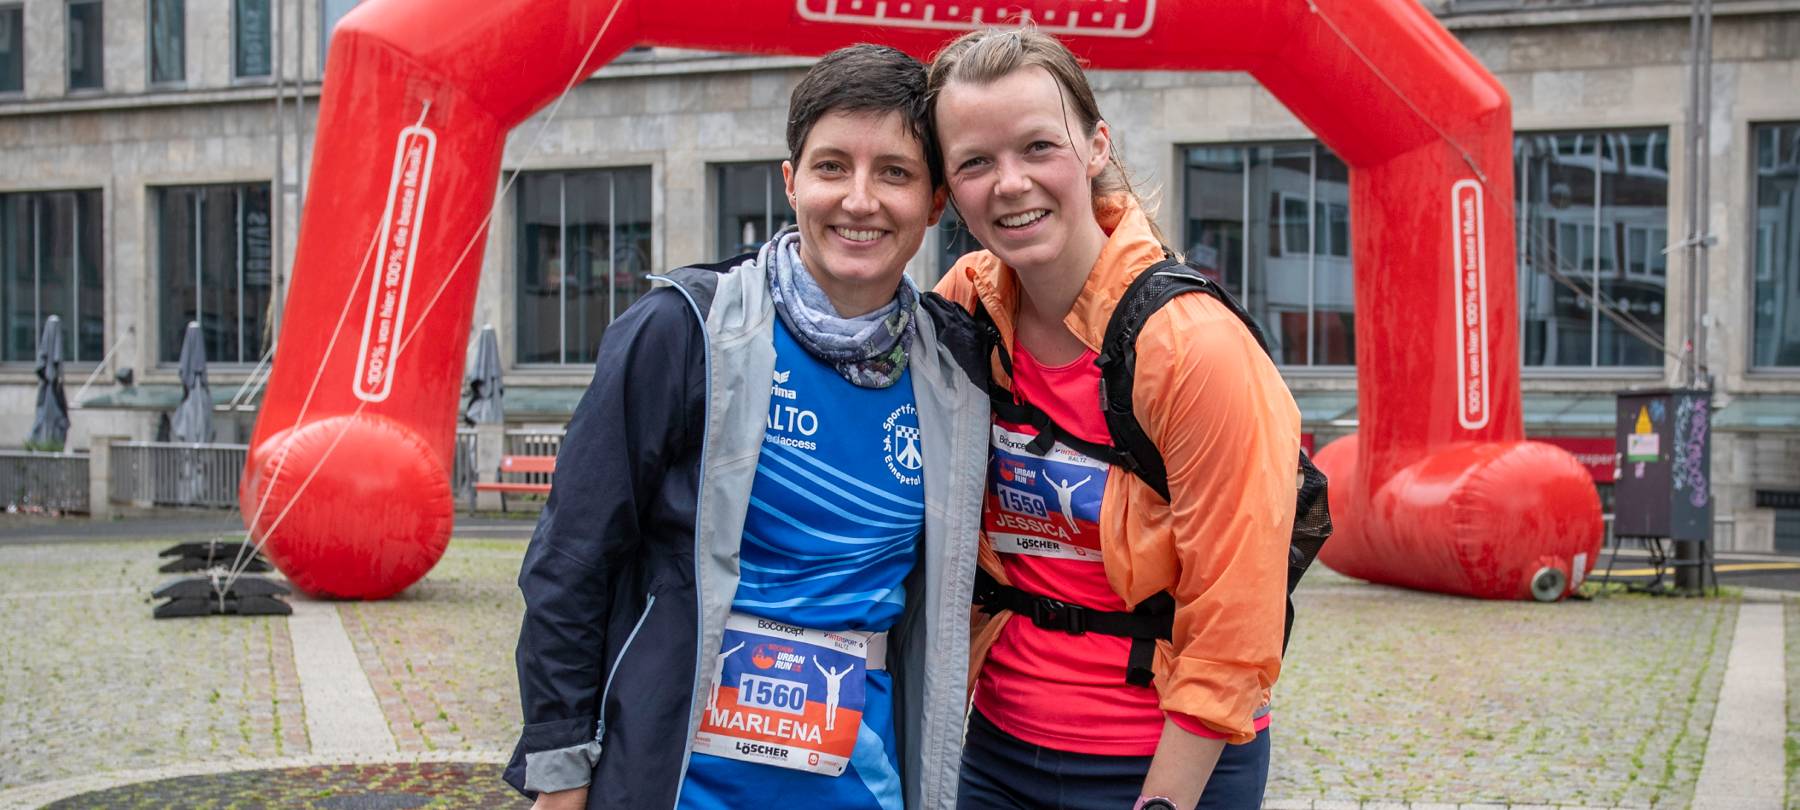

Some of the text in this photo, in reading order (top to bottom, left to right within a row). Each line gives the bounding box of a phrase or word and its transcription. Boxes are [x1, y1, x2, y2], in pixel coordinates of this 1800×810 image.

[396, 187, 416, 225] beste
[393, 226, 408, 247] die
[385, 248, 405, 288] 100%
[378, 318, 391, 343] von
[367, 344, 386, 385] 100%
[770, 384, 797, 400] rima
[882, 403, 918, 432] Sportfr
[884, 454, 921, 486] Ennepetal
[1000, 489, 1048, 518] 1559
[996, 513, 1072, 542] JESSICA
[1017, 537, 1061, 550] LÖSCHER
[757, 619, 805, 637] BoConcept
[774, 660, 793, 671] RUN
[777, 651, 806, 665] URBAN
[742, 679, 805, 711] 1560
[709, 705, 823, 745] MARLENA
[735, 741, 789, 758] LÖSCHER
